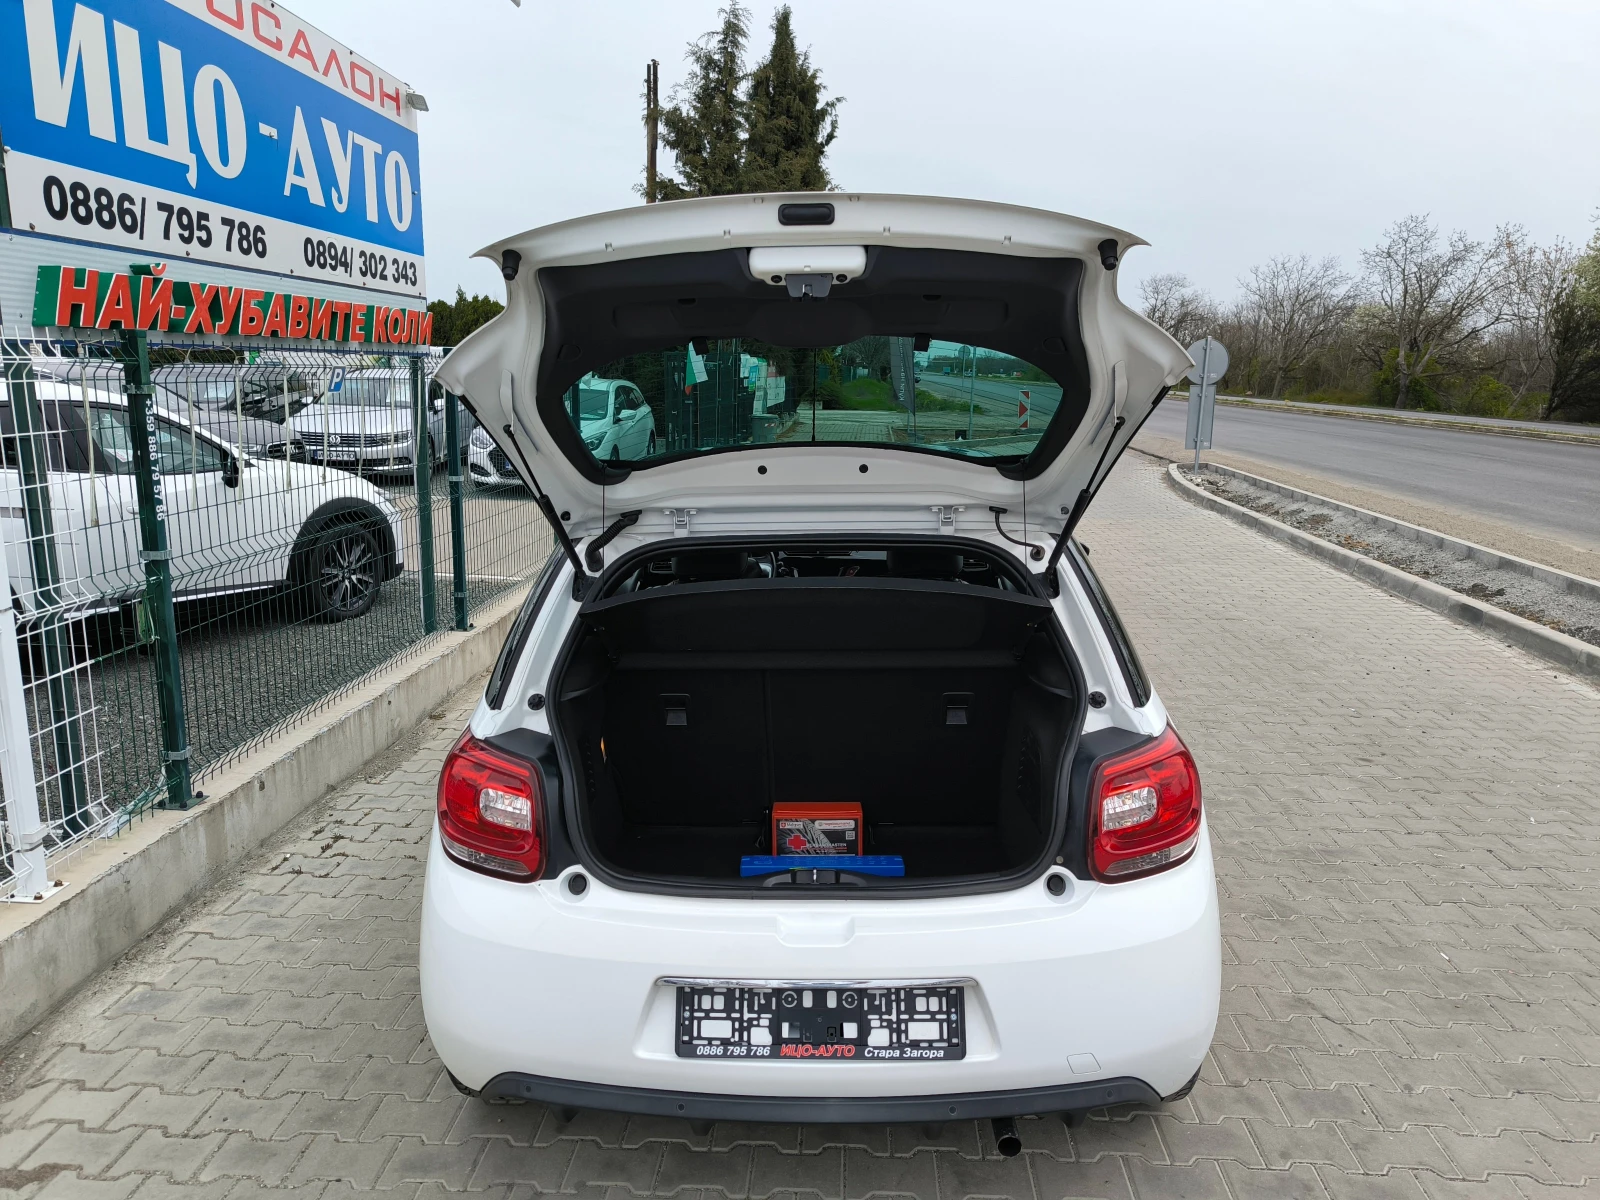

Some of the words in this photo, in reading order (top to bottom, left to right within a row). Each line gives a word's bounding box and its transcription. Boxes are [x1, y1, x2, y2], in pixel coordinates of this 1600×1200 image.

[43, 175, 146, 240] 0886/
[157, 202, 212, 248] 795
[221, 217, 267, 259] 786
[303, 236, 353, 278] 0894/
[358, 253, 388, 281] 302
[392, 260, 418, 287] 343
[56, 262, 366, 343] НАЙ-ХУБАВИТЕ
[373, 304, 433, 346] КОЛИ
[145, 398, 155, 432] +359
[147, 436, 158, 461] 886
[151, 464, 160, 481] 79
[153, 484, 163, 500] 57
[156, 504, 165, 521] 86
[696, 1046, 723, 1056] 0886
[727, 1046, 747, 1056] 795
[750, 1046, 770, 1056] 786
[780, 1044, 855, 1058] ИЦО-АУТО
[864, 1049, 900, 1059] Стара
[903, 1049, 944, 1059] Загора
